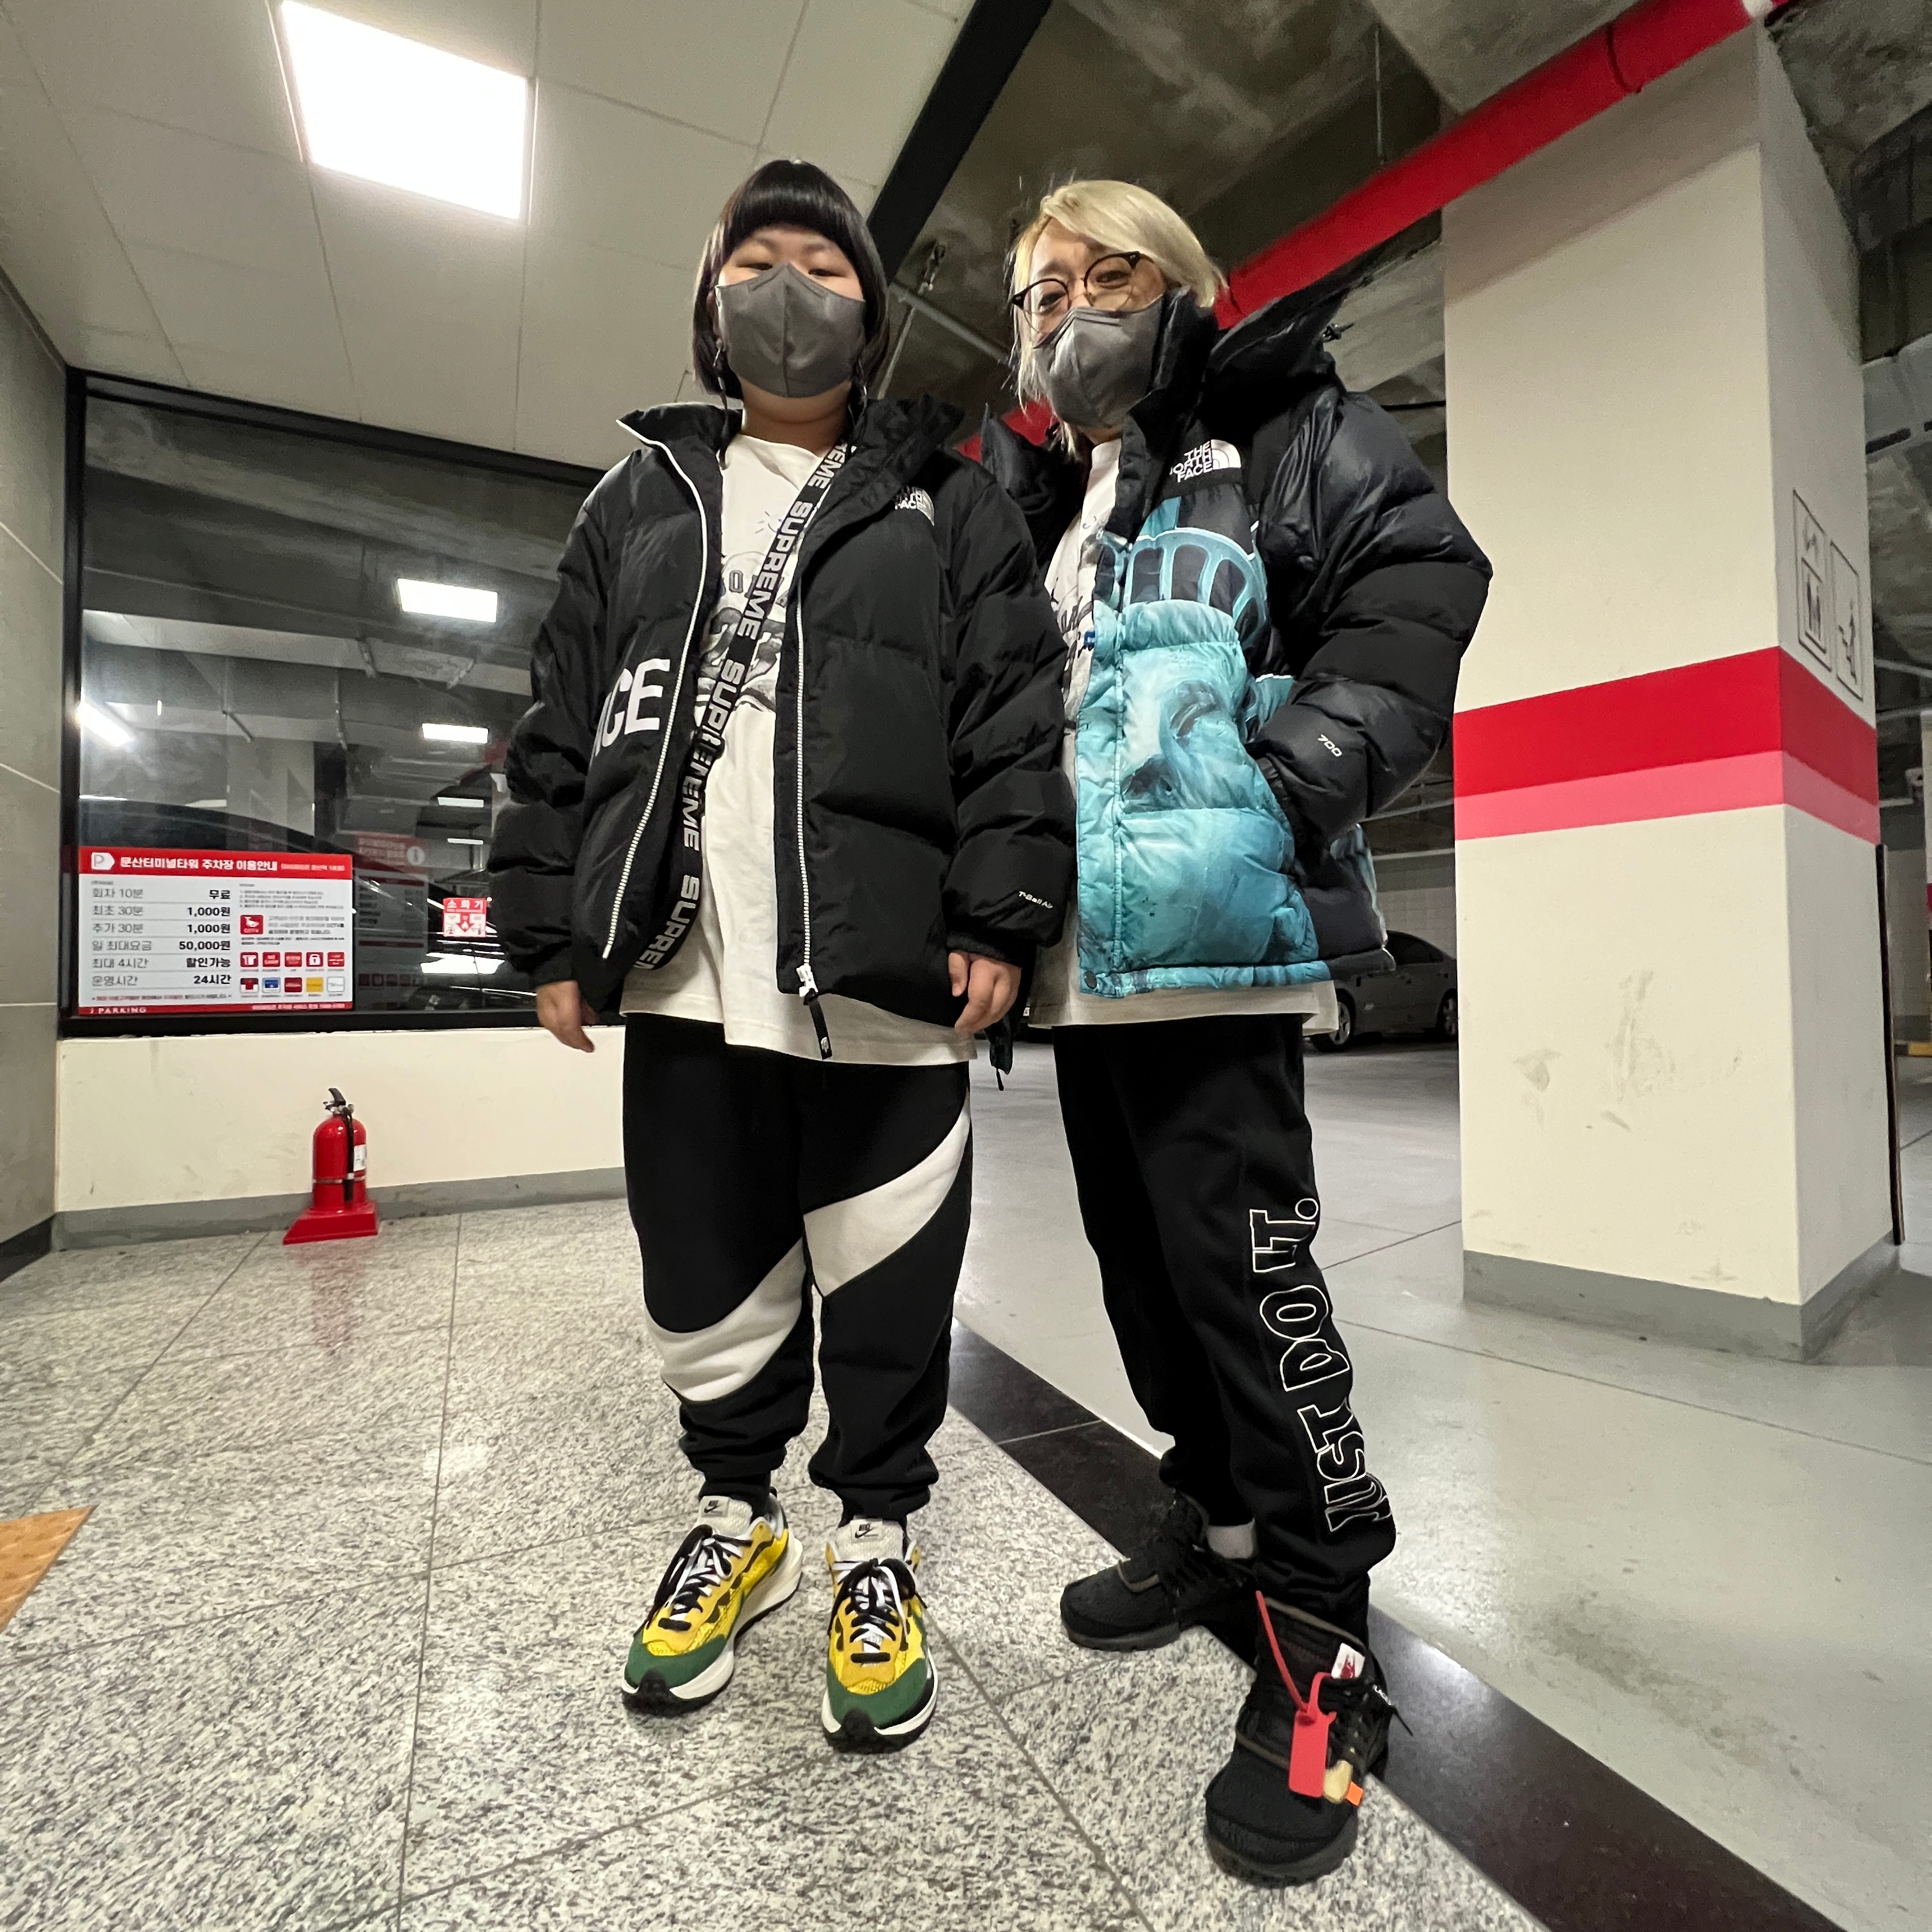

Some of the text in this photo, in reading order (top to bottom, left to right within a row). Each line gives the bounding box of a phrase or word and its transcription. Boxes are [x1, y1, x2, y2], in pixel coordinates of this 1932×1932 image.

[1184, 441, 1210, 461] THE
[1177, 461, 1213, 483] FACE
[737, 501, 813, 640] SUPREME
[202, 859, 234, 871] 주차장
[236, 860, 279, 871] 이용안내
[209, 889, 231, 900] 무료
[447, 899, 484, 909] 소화기
[187, 907, 231, 917] 1,000원
[187, 924, 231, 934] 1,000원
[179, 940, 231, 951] 50,000원
[193, 974, 232, 985] 24시간
[1259, 1284, 1350, 1392] DO
